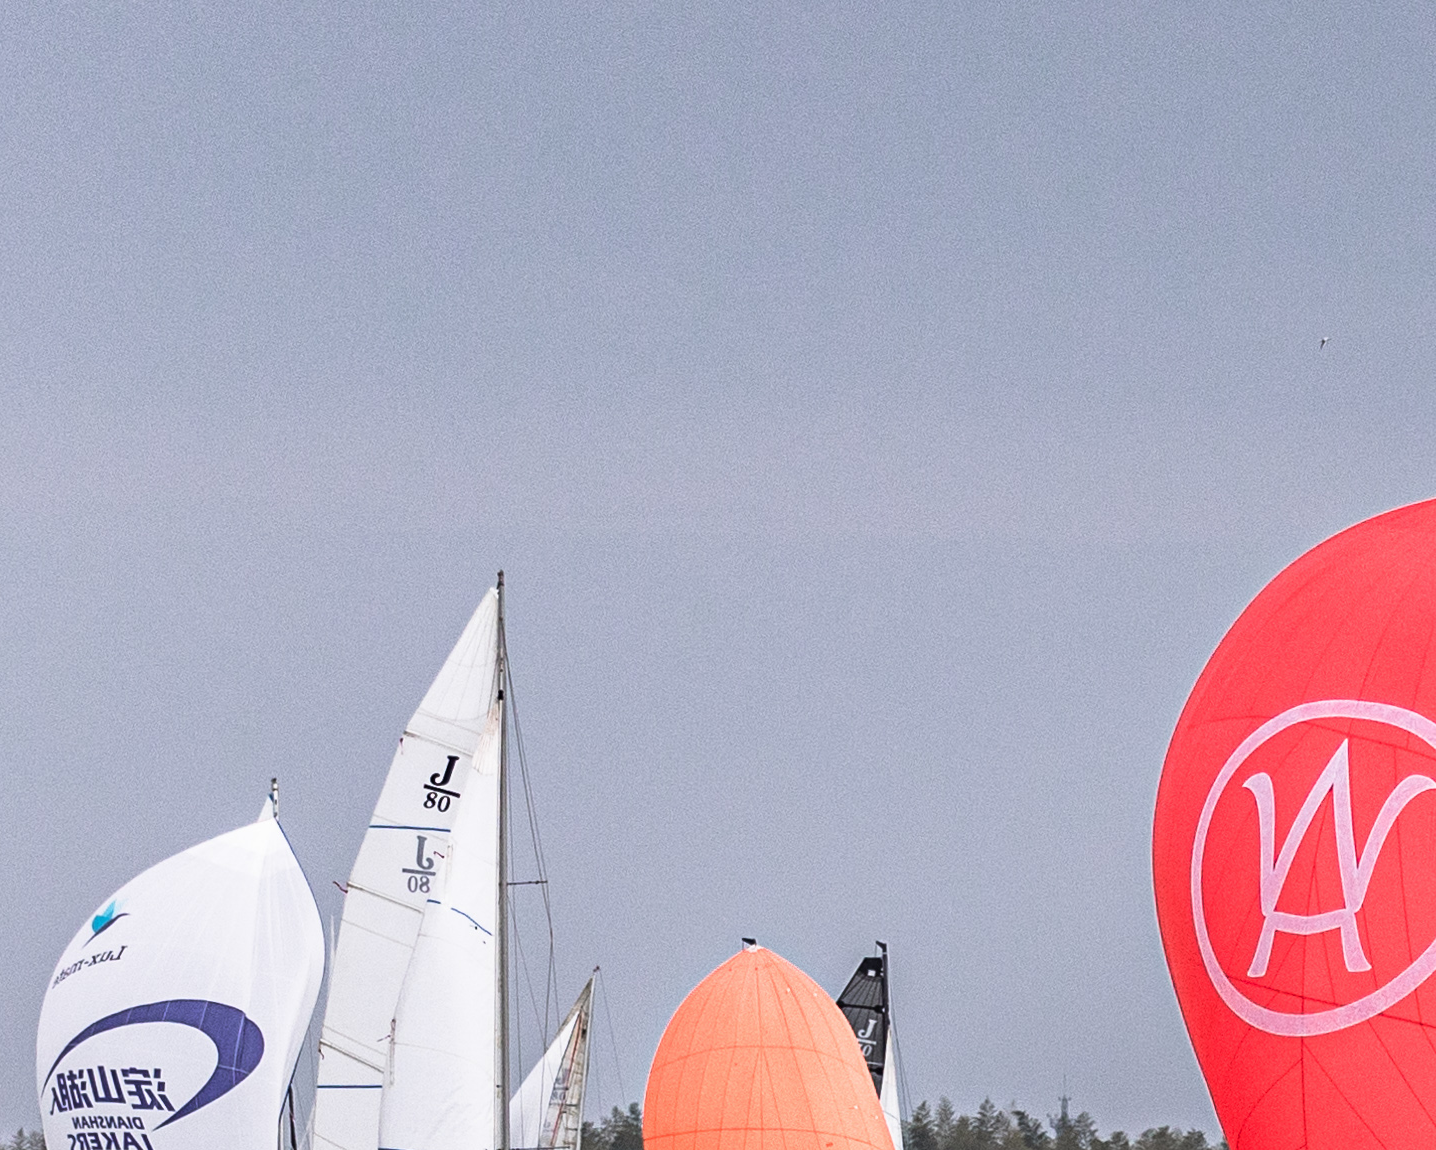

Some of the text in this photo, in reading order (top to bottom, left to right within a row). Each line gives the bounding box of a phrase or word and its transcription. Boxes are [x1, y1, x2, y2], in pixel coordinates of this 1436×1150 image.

[430, 755, 460, 786] J
[423, 792, 451, 812] 80
[858, 1019, 877, 1038] J
[860, 1044, 872, 1057] 0
